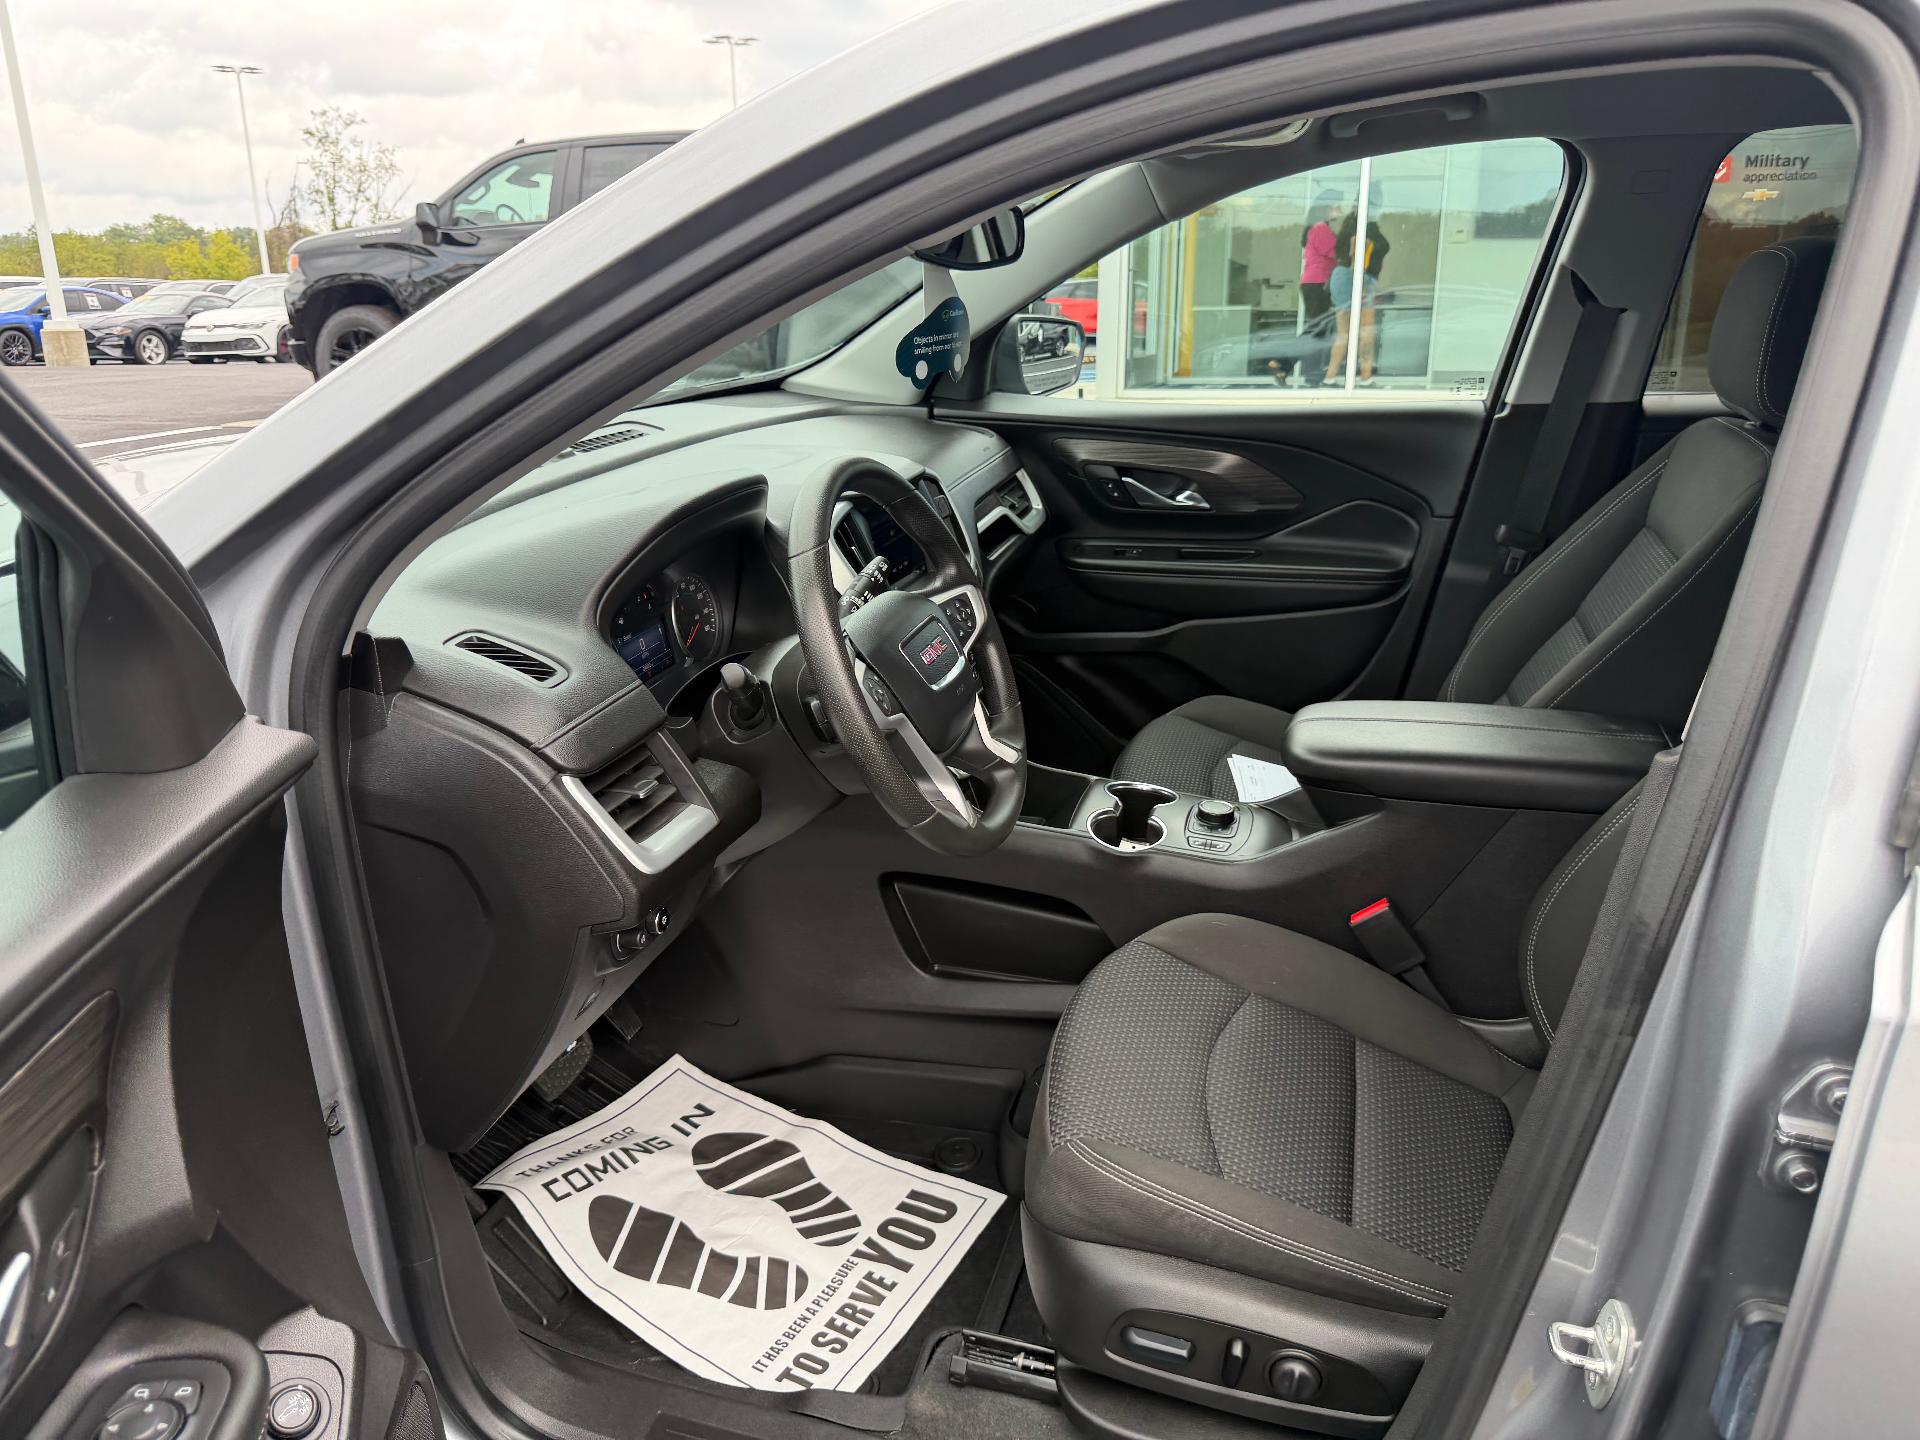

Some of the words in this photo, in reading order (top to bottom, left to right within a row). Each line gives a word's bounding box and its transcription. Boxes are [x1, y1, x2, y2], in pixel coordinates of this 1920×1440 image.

[1744, 154, 1810, 169] Military
[1743, 171, 1817, 184] appreciation
[913, 336, 933, 346] Objects
[919, 635, 948, 666] GMC
[515, 1143, 602, 1178] THANKS
[599, 1125, 639, 1146] FOR
[540, 1136, 676, 1203] COMING
[670, 1102, 717, 1138] IN
[849, 1188, 958, 1275] YOU
[811, 1257, 860, 1309] PLEASURE
[804, 1306, 820, 1317] A
[810, 1269, 899, 1355] SERVE
[782, 1313, 813, 1341] BEEN
[762, 1339, 790, 1362] HAS
[751, 1359, 770, 1374] IT
[774, 1352, 830, 1390] TO
